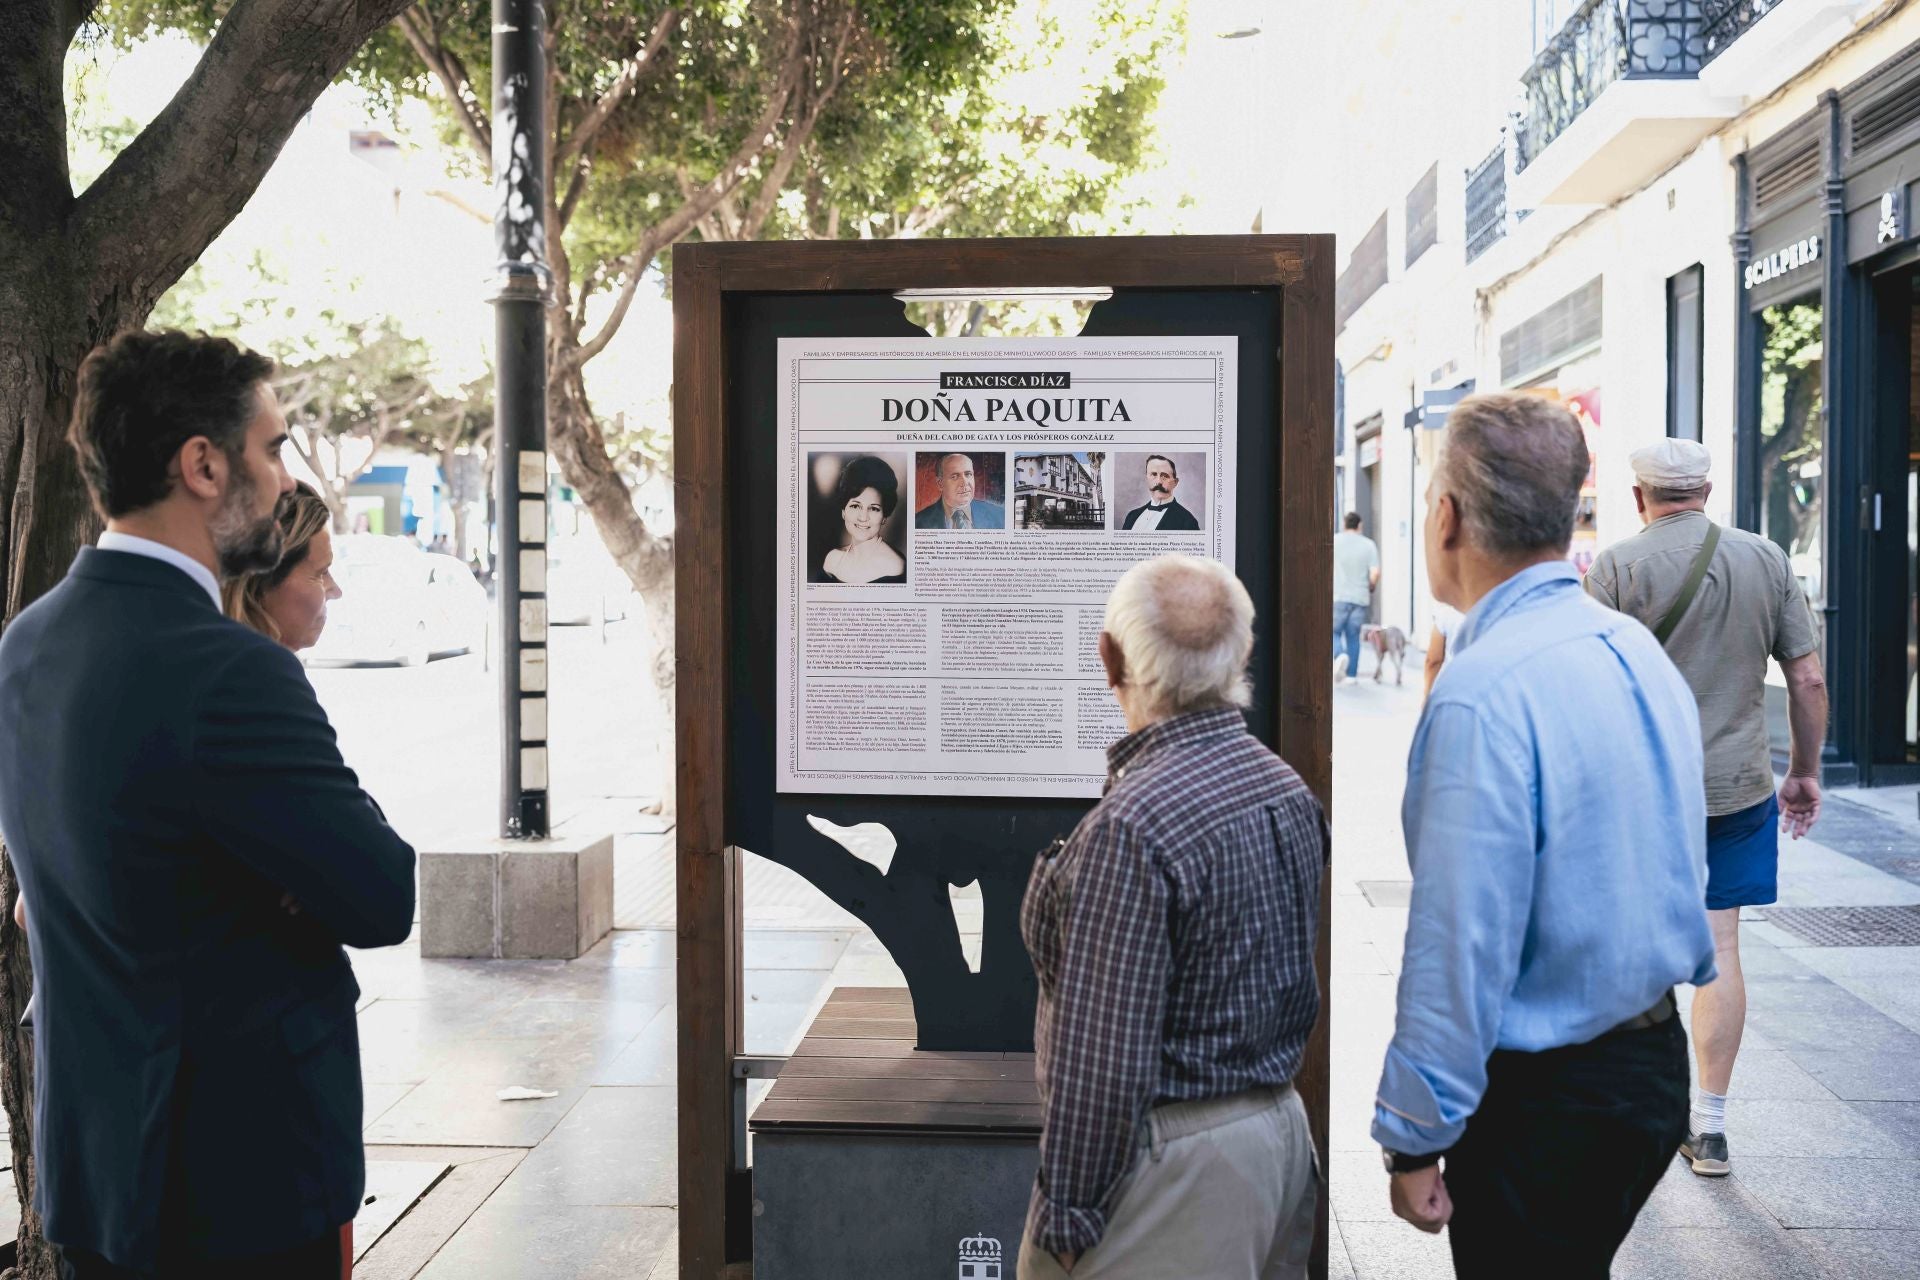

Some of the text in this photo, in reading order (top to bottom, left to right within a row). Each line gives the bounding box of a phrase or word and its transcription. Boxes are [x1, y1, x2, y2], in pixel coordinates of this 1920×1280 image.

[1744, 236, 1818, 290] SCALPERS
[946, 374, 1065, 386] FRANCISCA DÍAZ
[1218, 372, 1224, 381] EN
[881, 392, 1132, 427] DOÑA PAQUITA
[1218, 415, 1223, 423] DE
[791, 432, 796, 440] DE
[791, 473, 796, 481] EN
[791, 510, 796, 518] DE
[791, 710, 796, 718] DE
